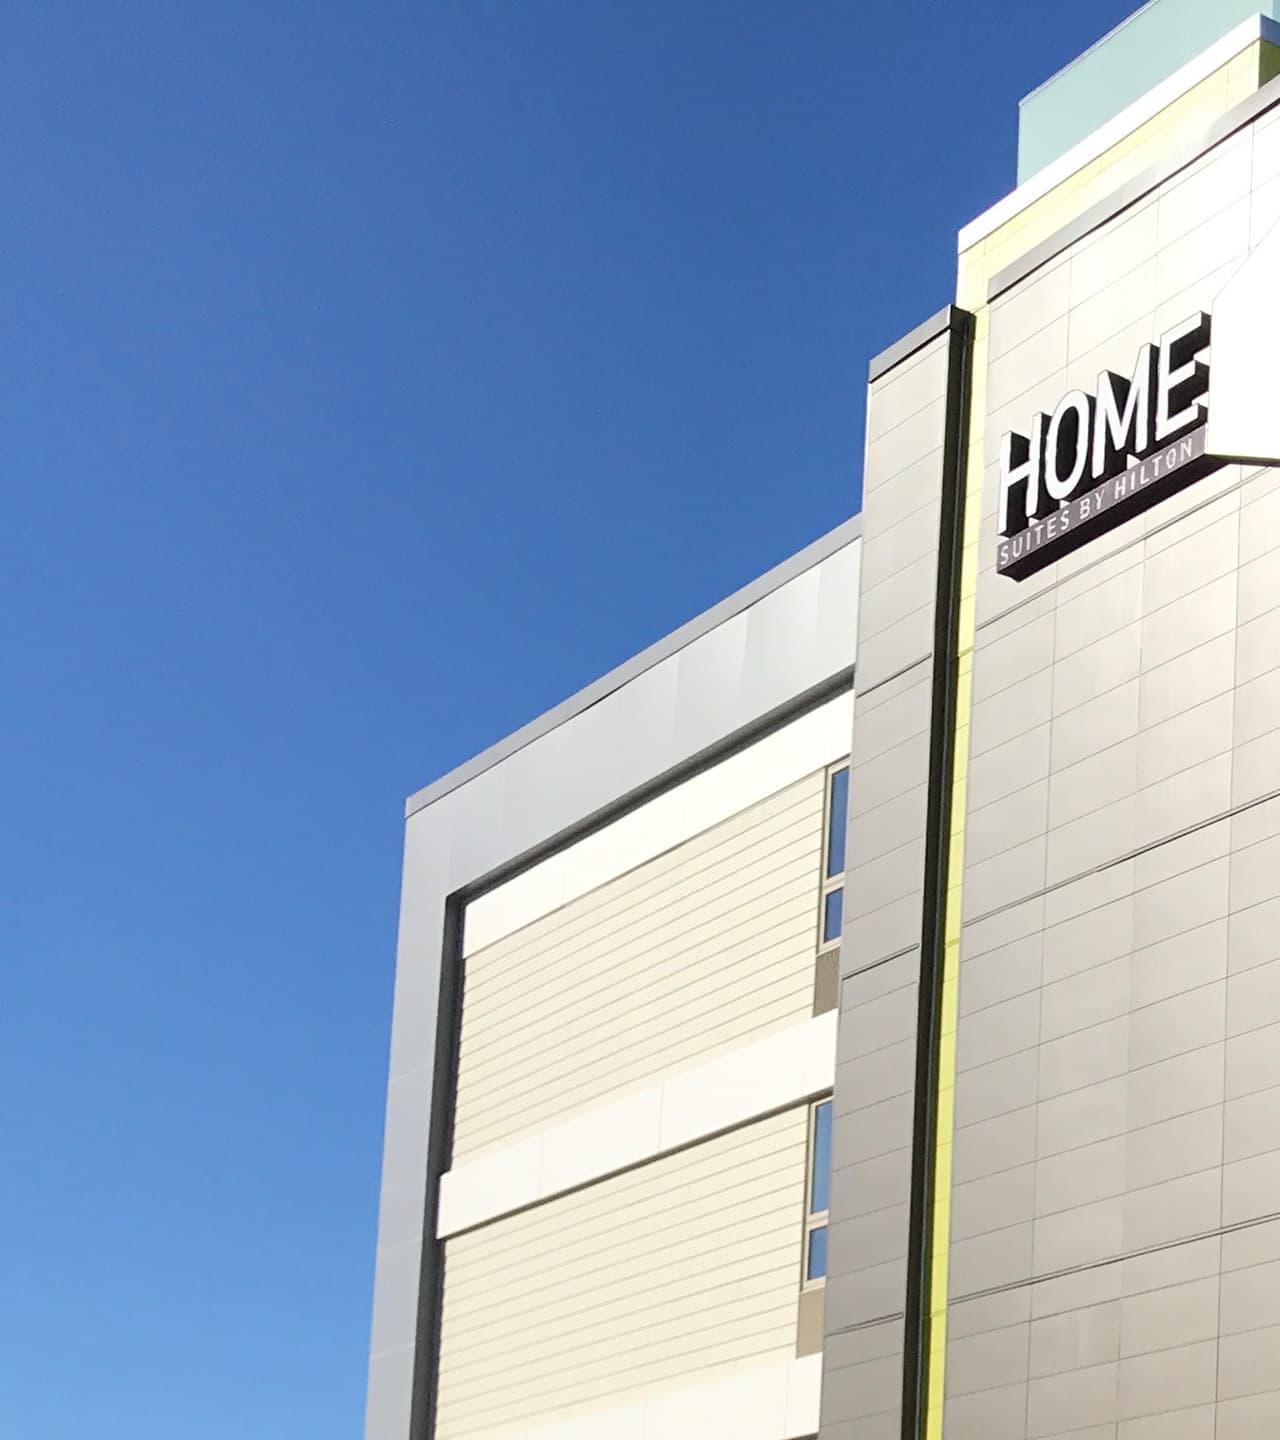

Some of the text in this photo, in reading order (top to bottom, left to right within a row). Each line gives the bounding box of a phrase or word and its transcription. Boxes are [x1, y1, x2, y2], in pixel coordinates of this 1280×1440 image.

[998, 311, 1209, 537] HOME
[1000, 437, 1193, 566] SUITES BY HILTON
